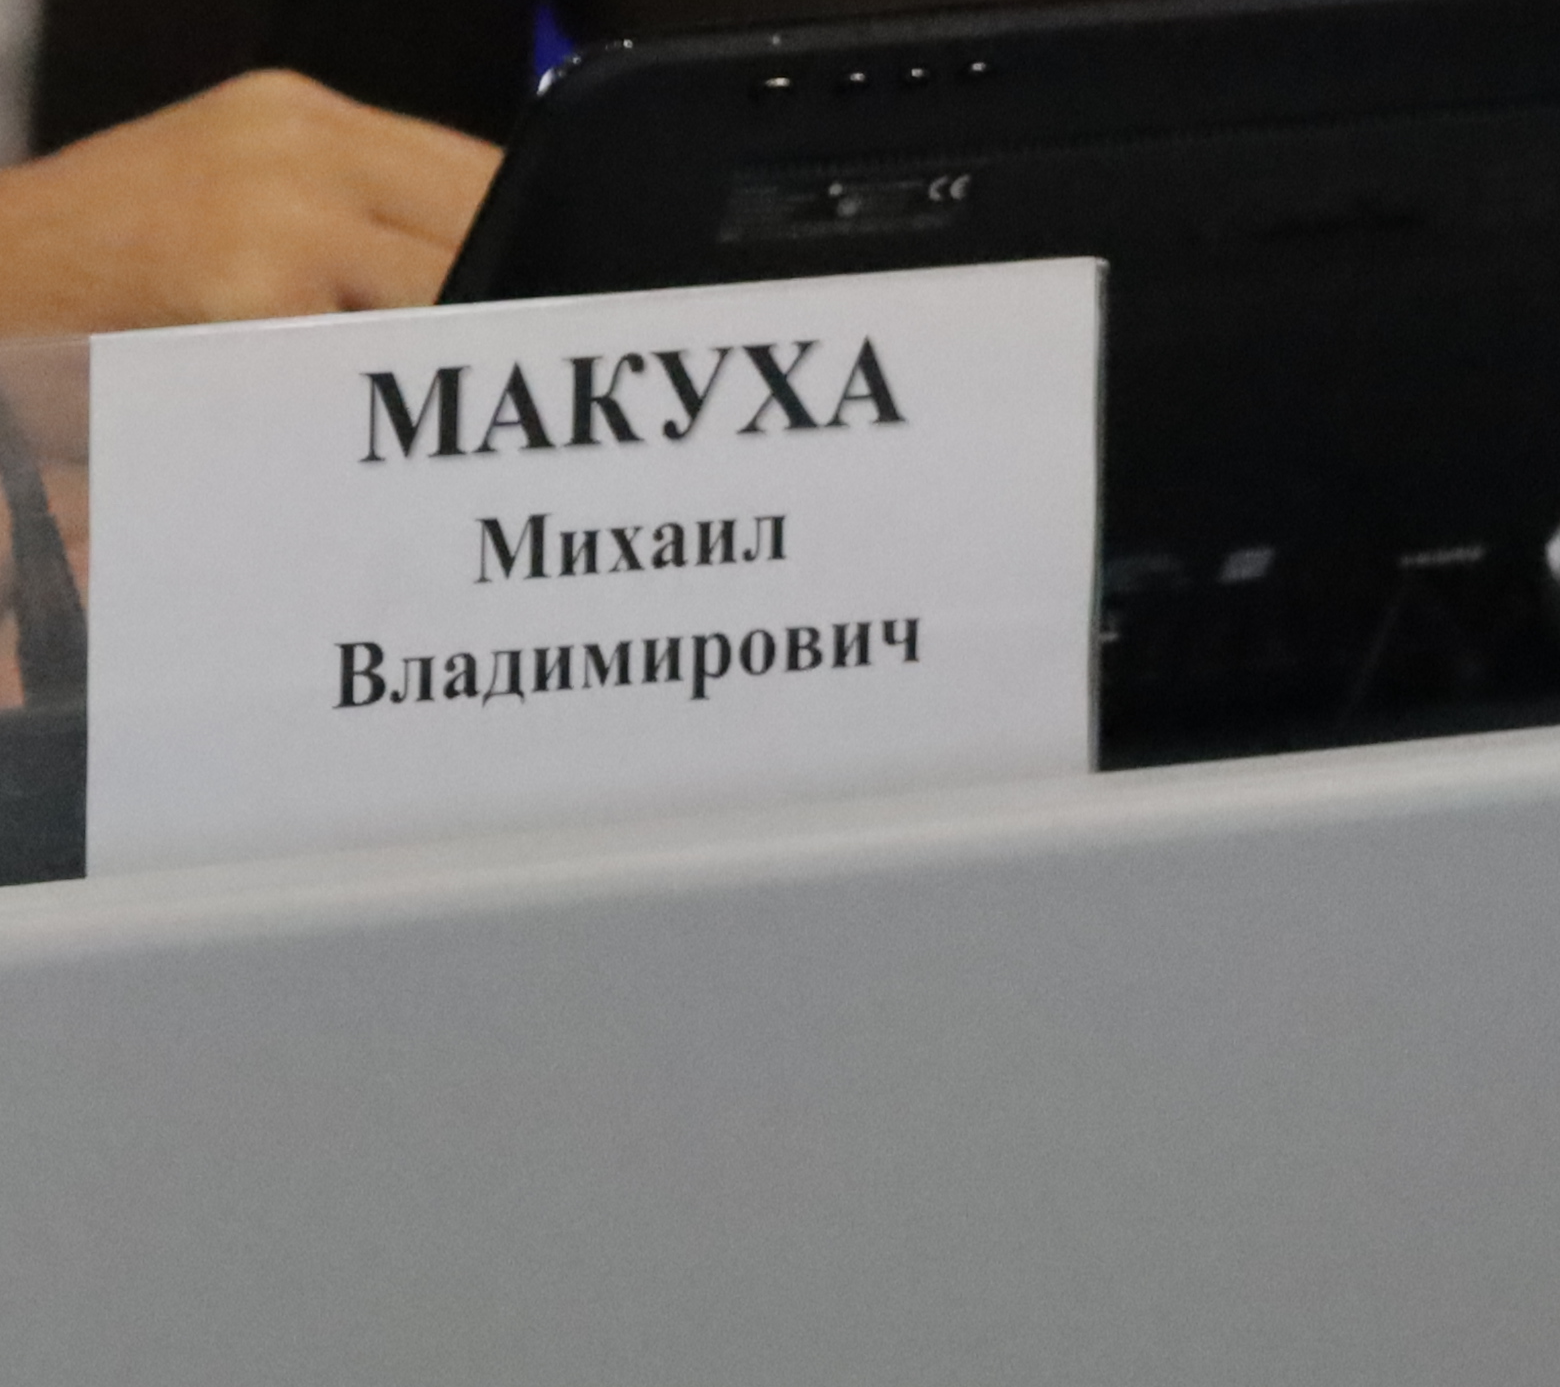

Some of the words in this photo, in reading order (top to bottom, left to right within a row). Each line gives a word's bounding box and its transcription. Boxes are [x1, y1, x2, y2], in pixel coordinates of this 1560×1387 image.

[359, 335, 907, 464] МАКУХА
[473, 514, 788, 584] Михаил
[333, 615, 923, 709] Владимирович
